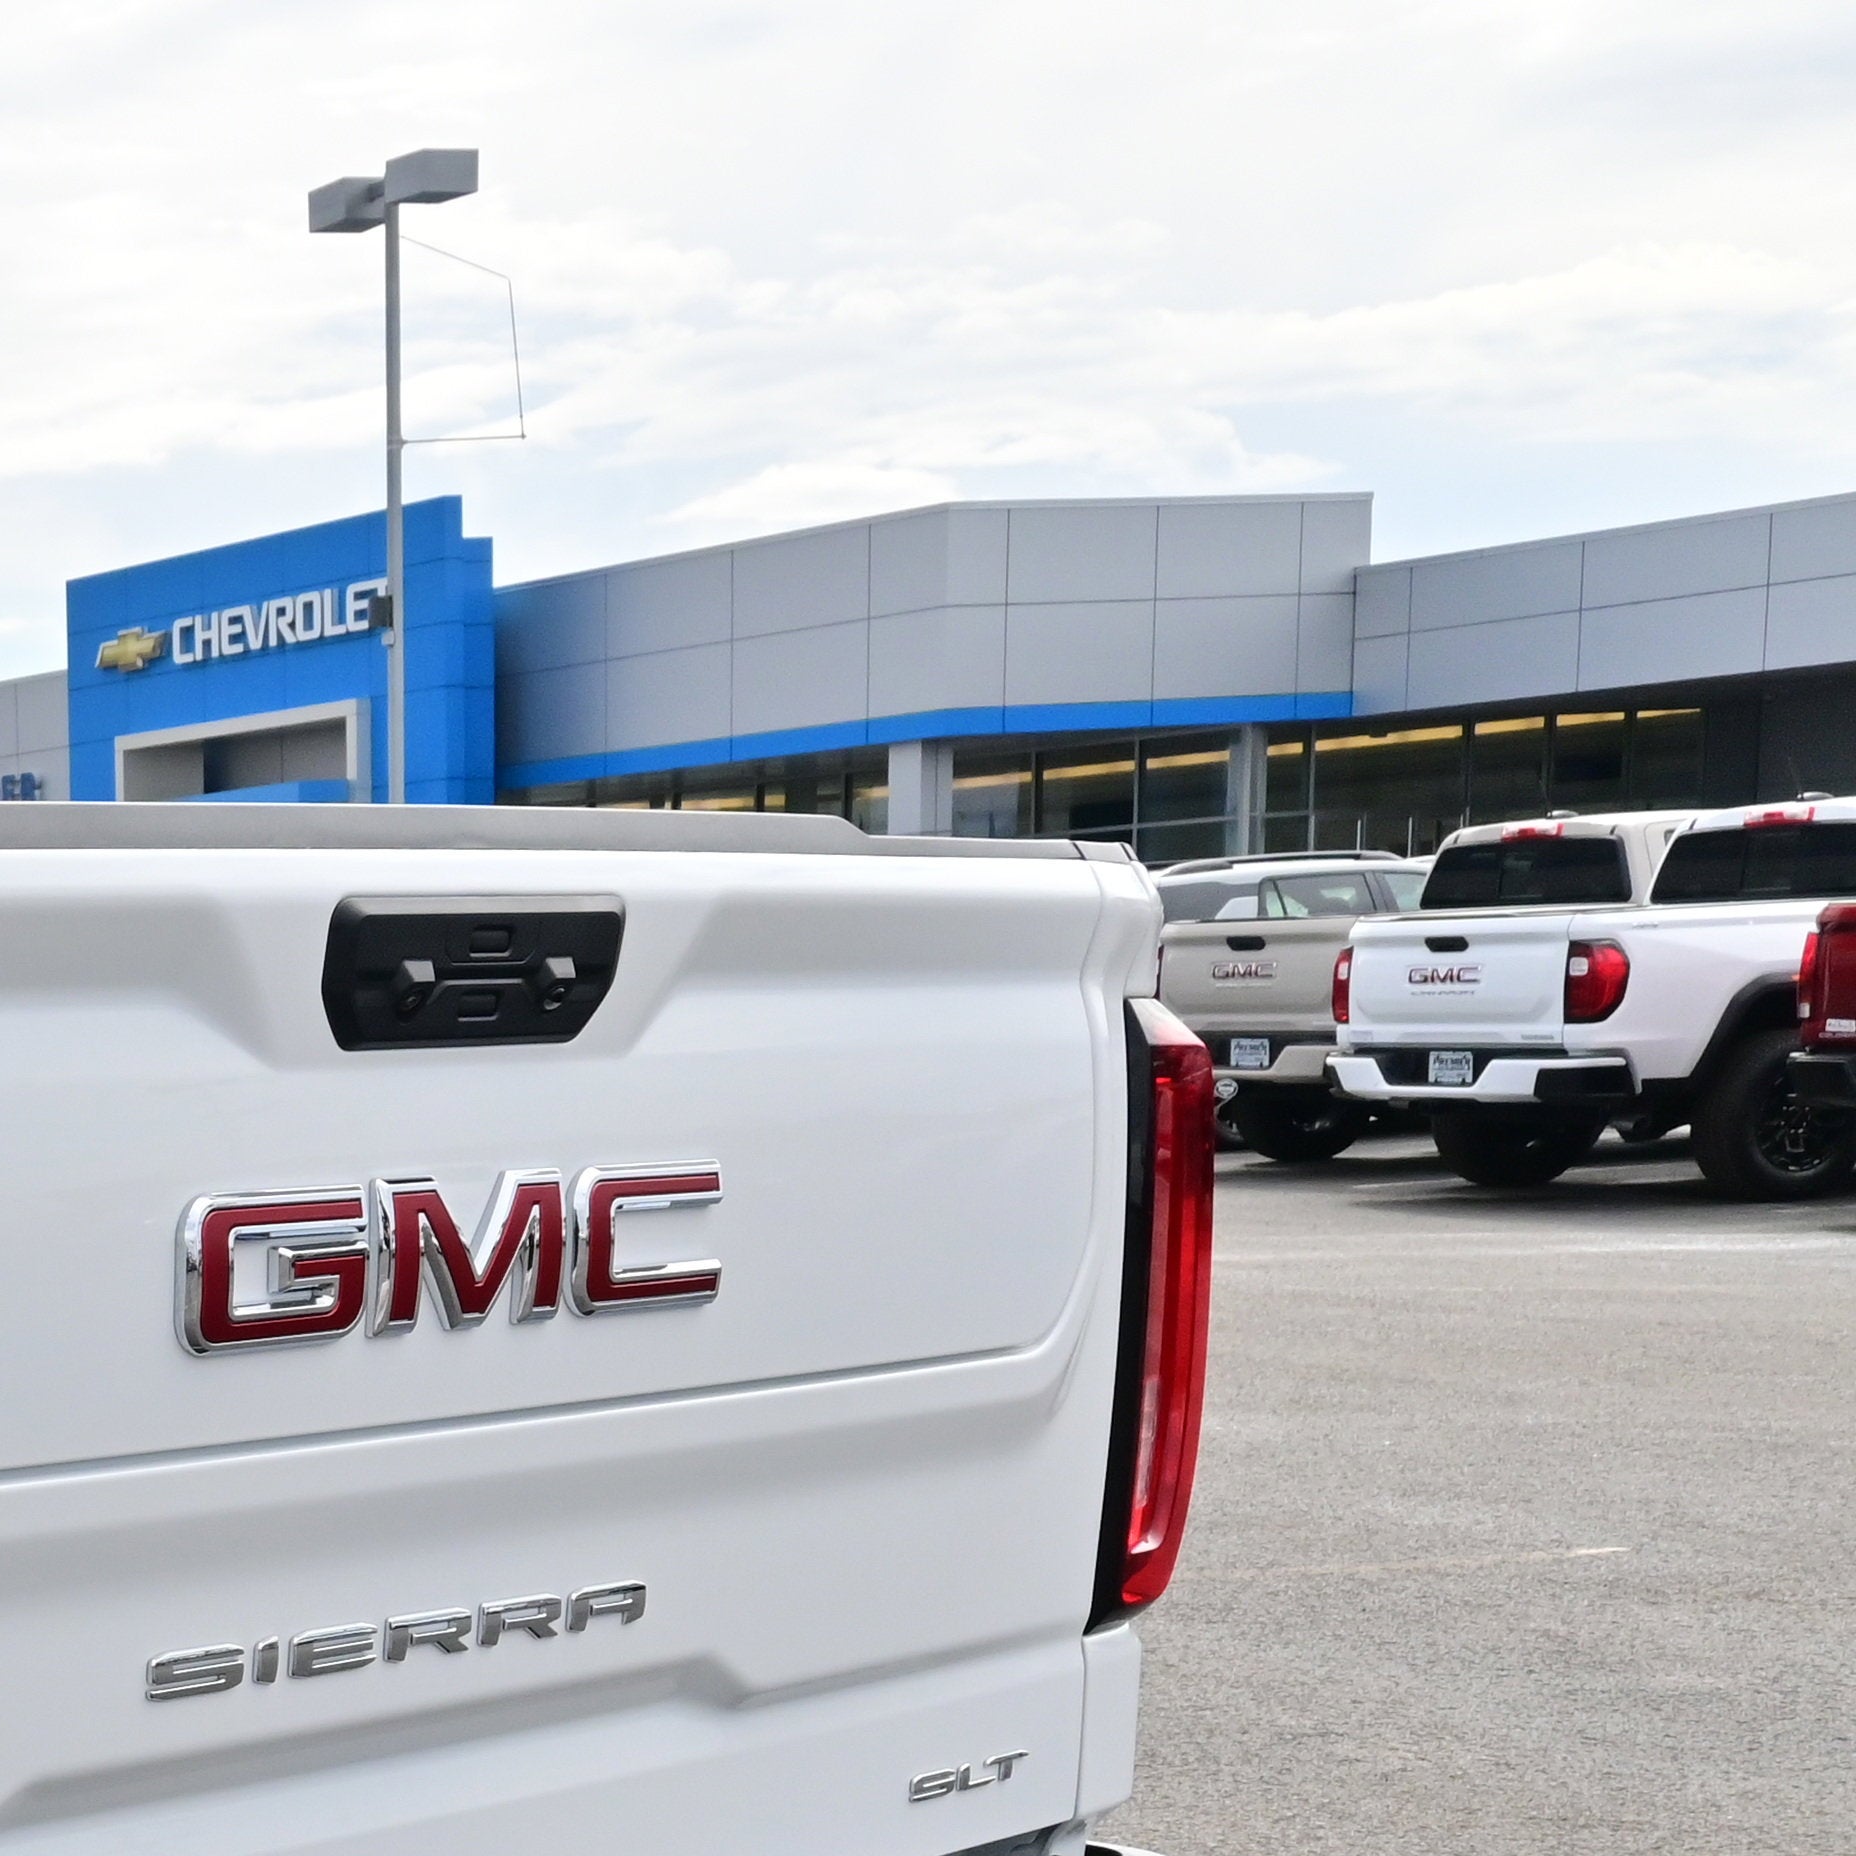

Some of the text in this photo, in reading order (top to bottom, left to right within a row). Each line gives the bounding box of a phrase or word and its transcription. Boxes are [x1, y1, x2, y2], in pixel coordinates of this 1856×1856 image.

[1211, 961, 1277, 981] GMC
[1408, 965, 1482, 985] GMC
[175, 1158, 724, 1356] GMC
[145, 1579, 646, 1700] SIERRA
[909, 1749, 1029, 1803] SLT
